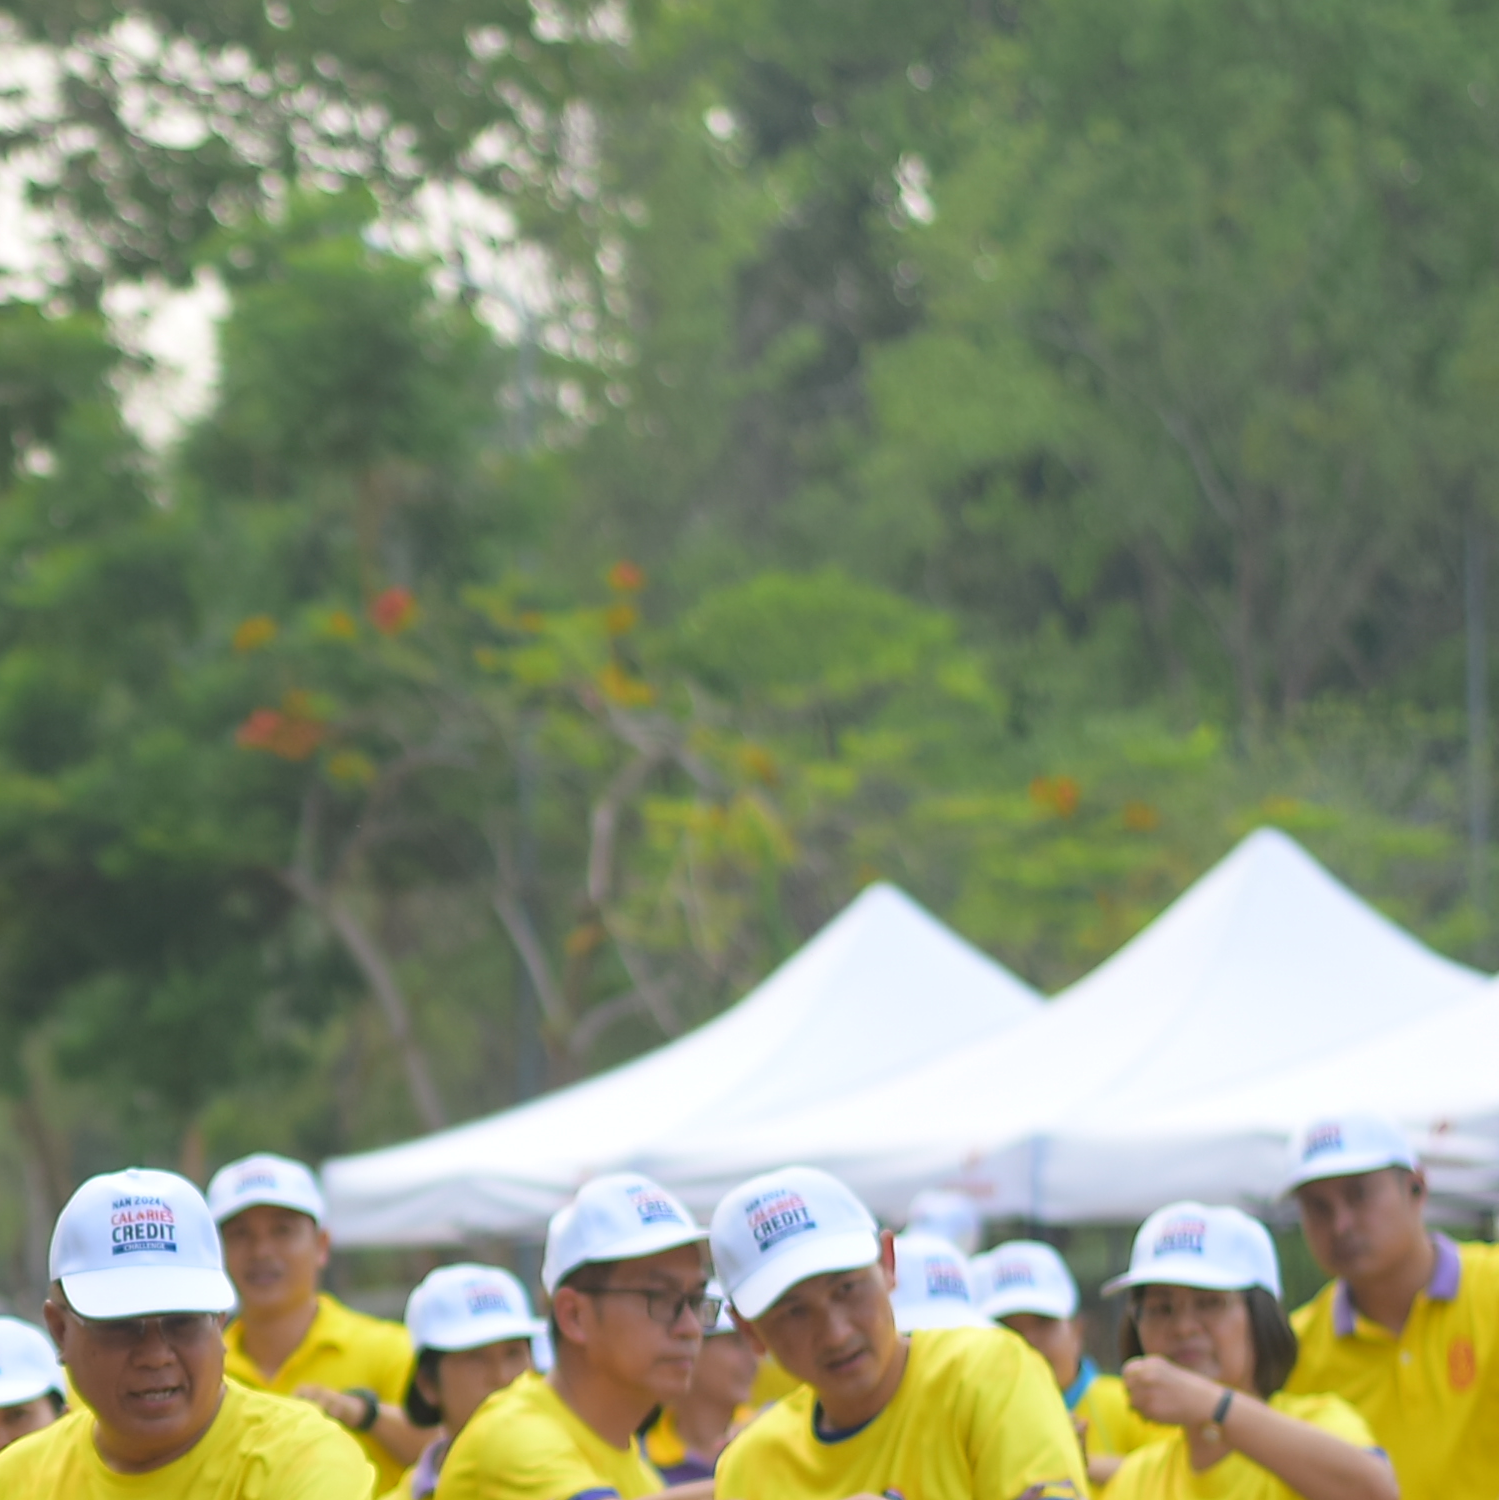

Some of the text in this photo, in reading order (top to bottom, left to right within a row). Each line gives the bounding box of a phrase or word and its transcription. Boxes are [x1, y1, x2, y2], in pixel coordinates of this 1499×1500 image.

[112, 1196, 160, 1210] NAN 2024
[112, 1222, 175, 1243] CREDIT
[753, 1206, 810, 1241] CREDIT
